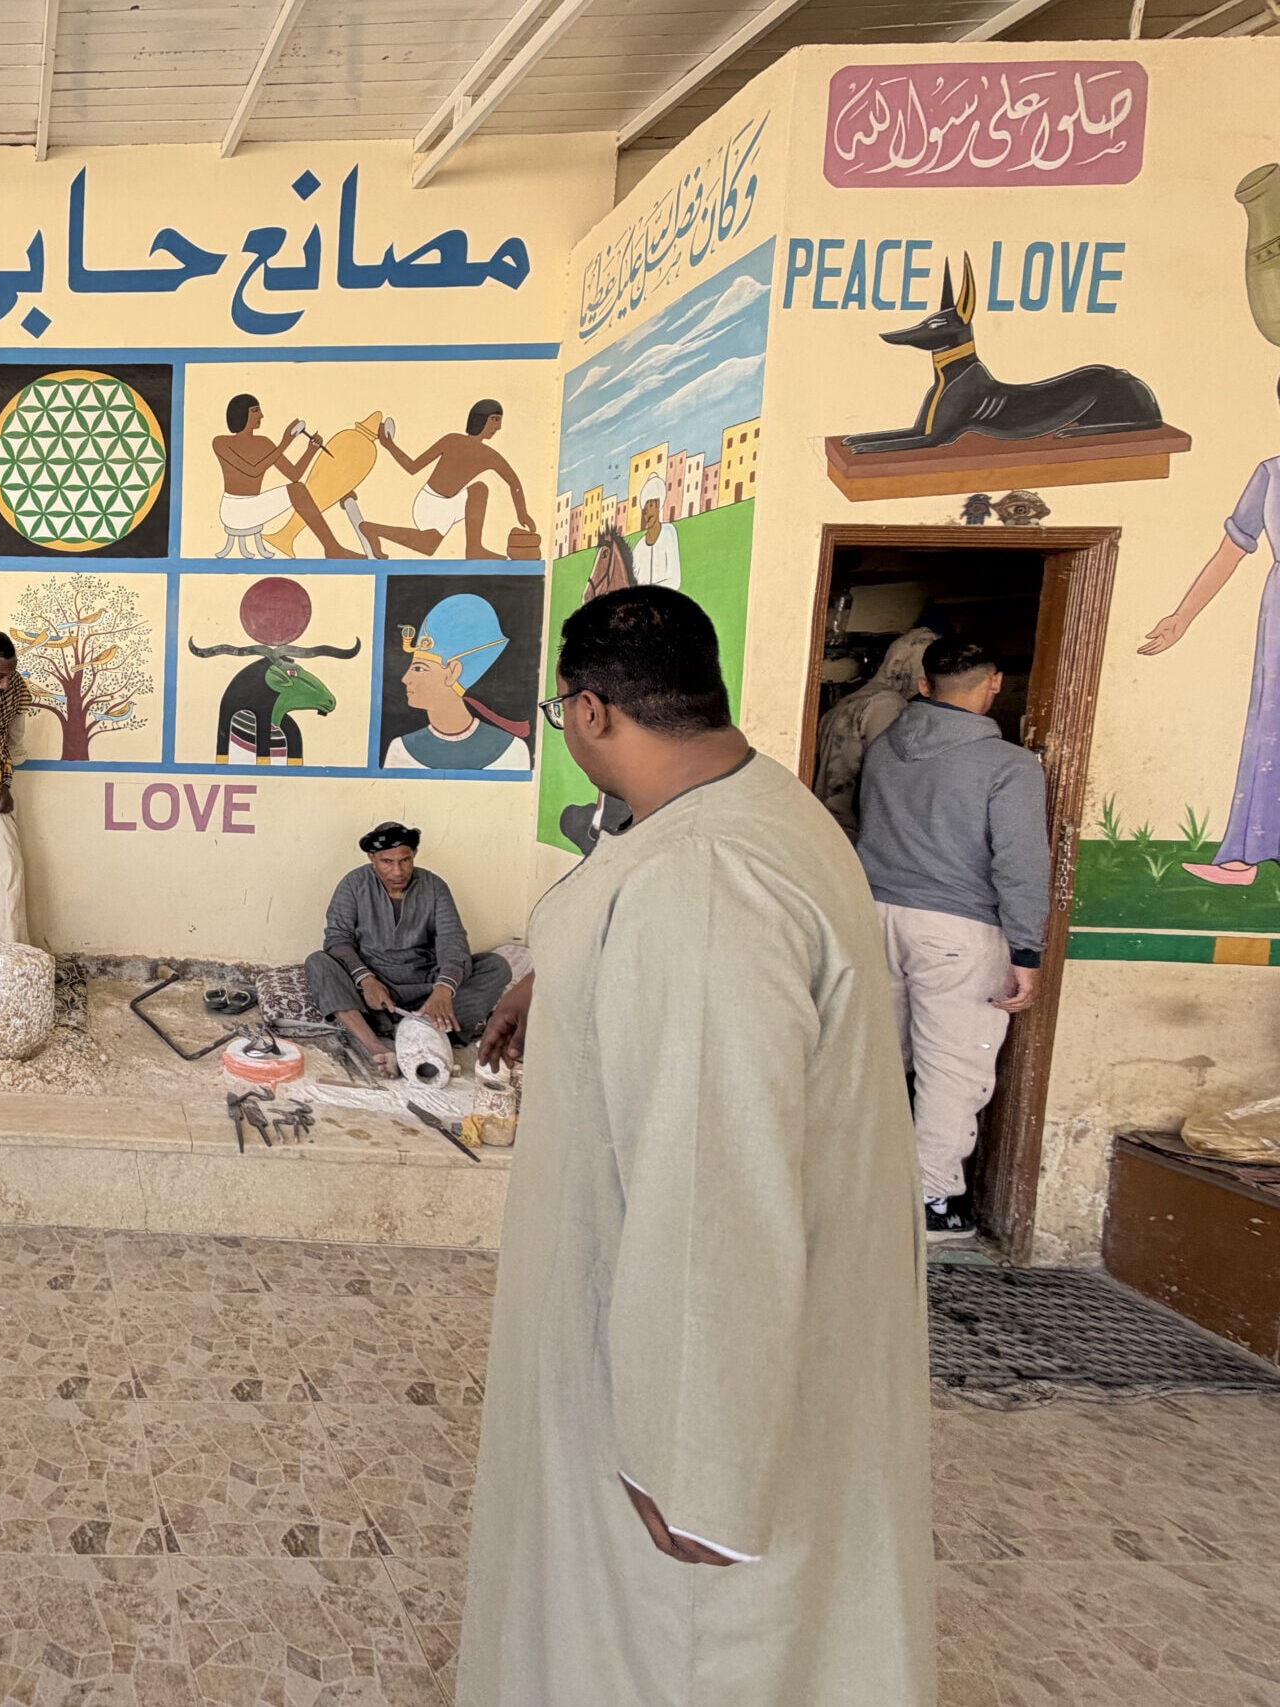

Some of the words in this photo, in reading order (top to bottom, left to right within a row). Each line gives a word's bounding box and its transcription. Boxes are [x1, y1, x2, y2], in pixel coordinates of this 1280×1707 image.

[230, 163, 532, 336] مصانع
[782, 237, 933, 312] PEACE
[986, 240, 1127, 315] LOVE
[103, 781, 258, 834] LOVE
